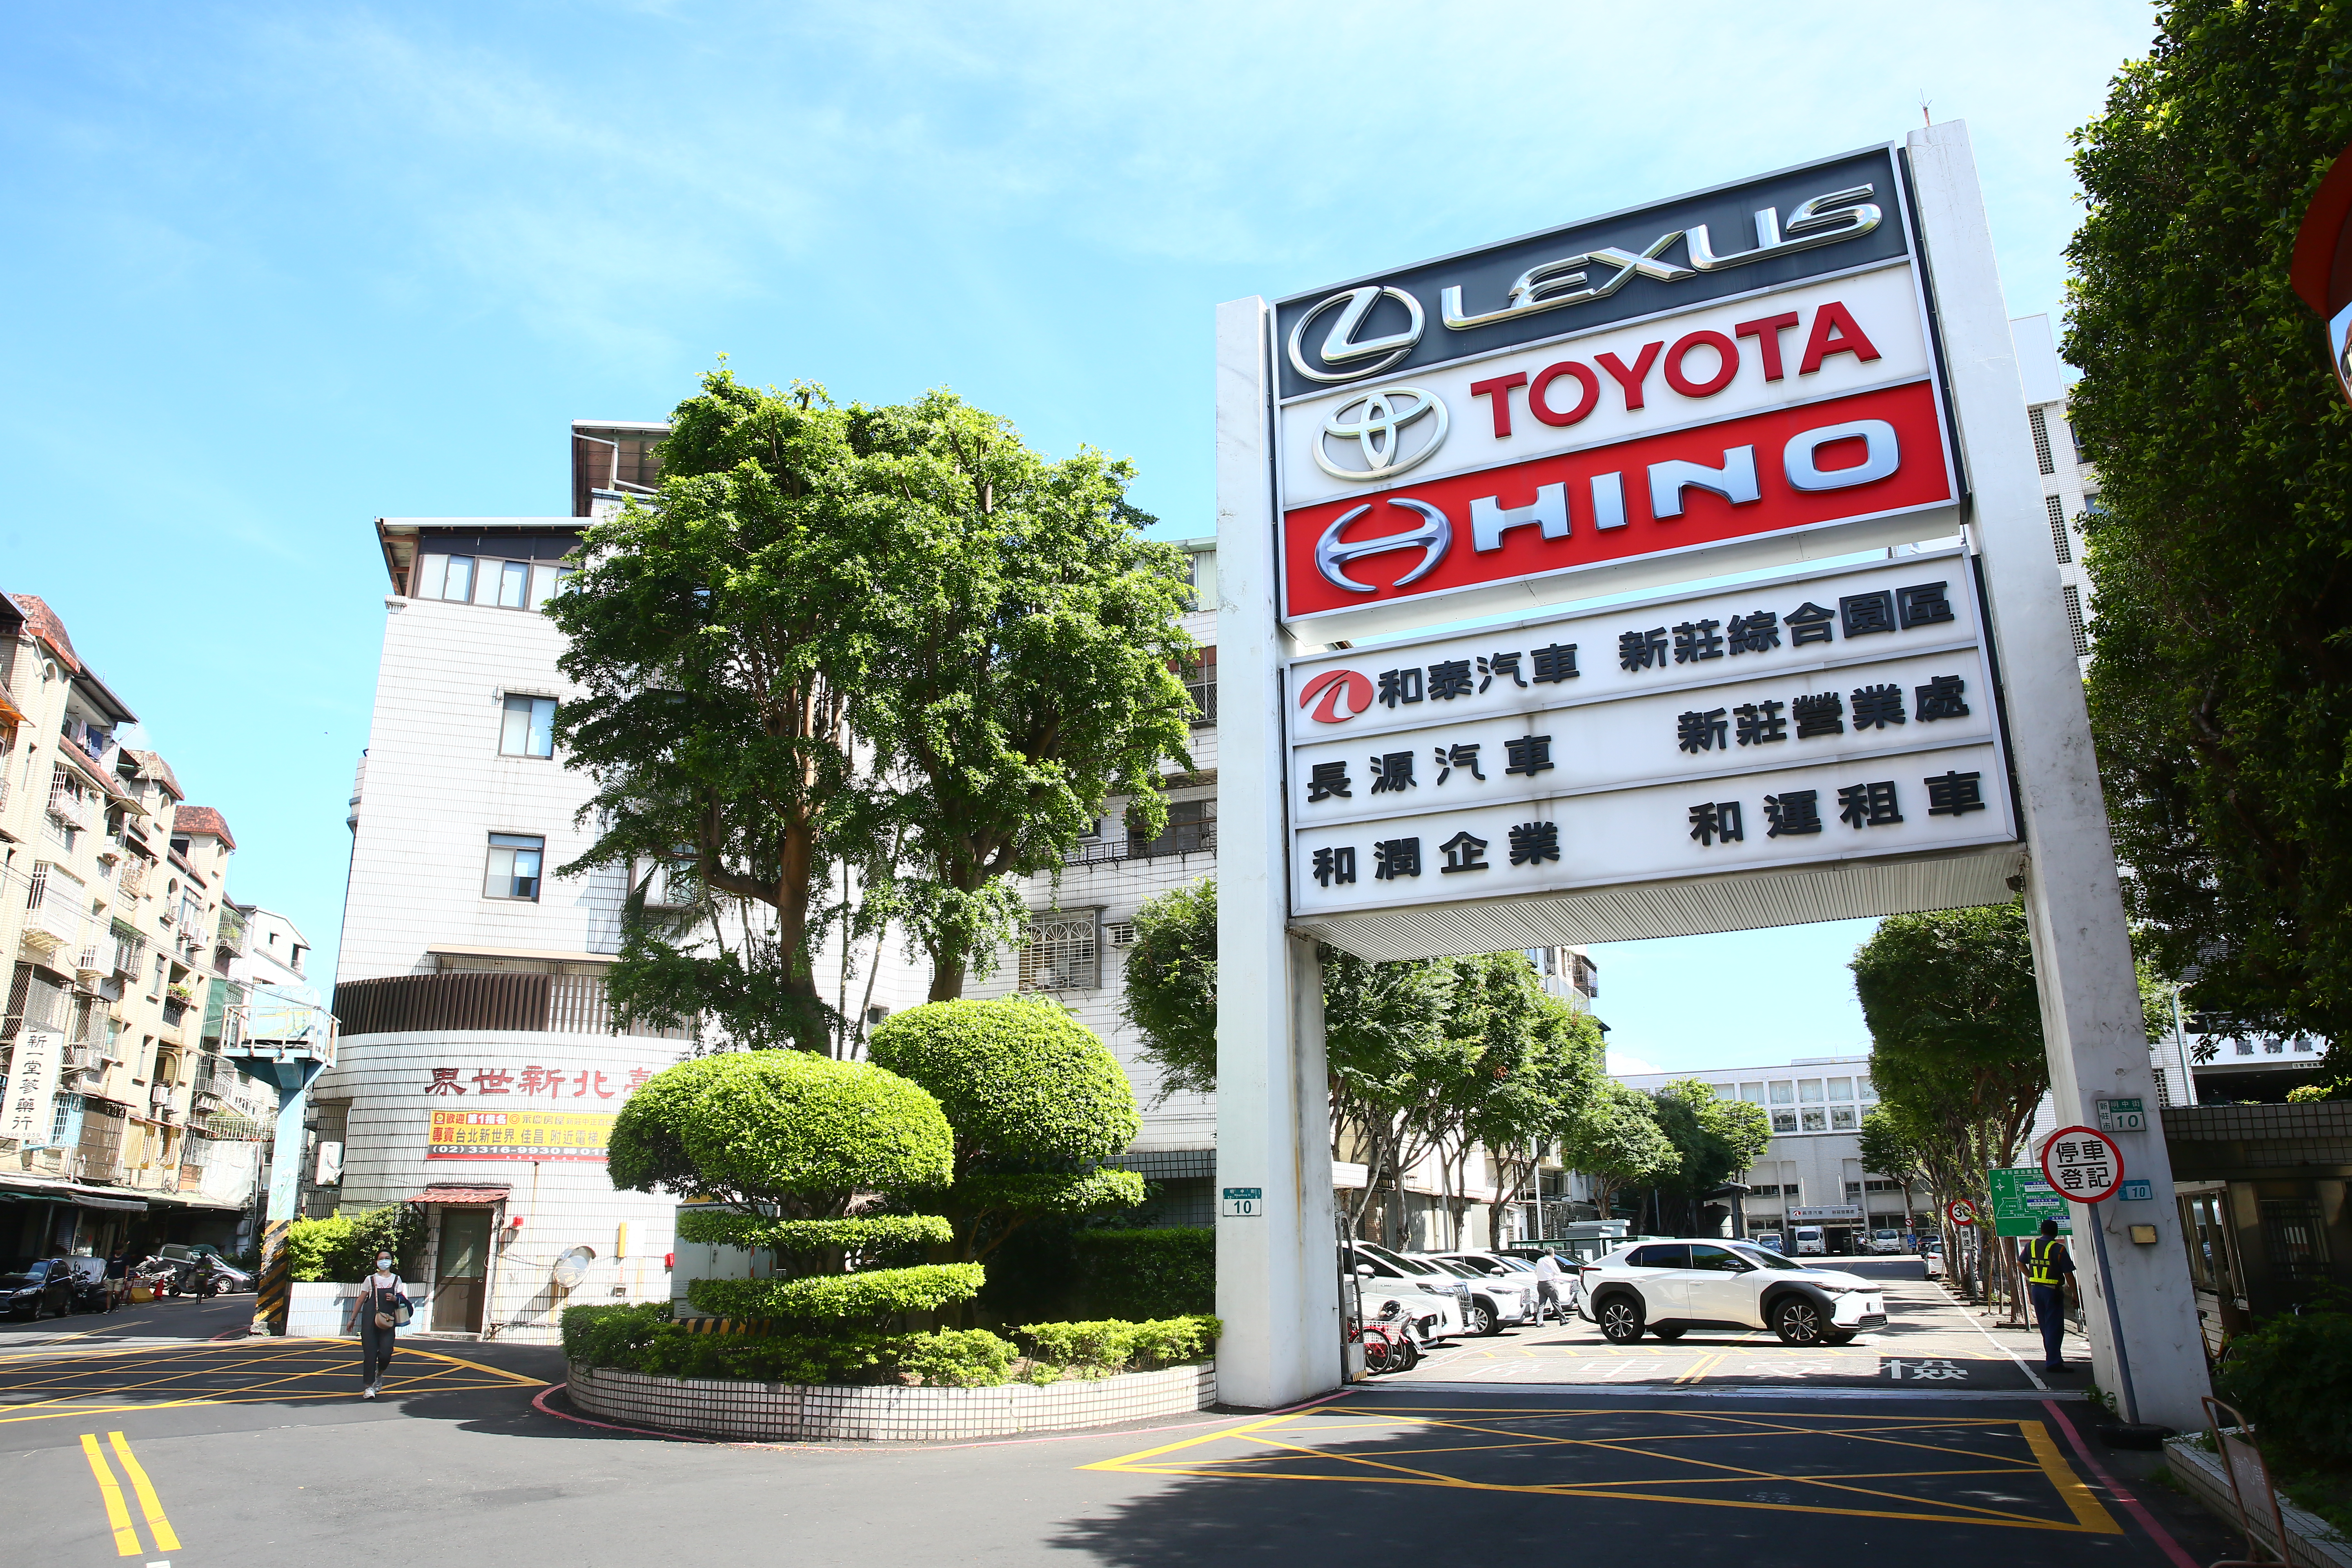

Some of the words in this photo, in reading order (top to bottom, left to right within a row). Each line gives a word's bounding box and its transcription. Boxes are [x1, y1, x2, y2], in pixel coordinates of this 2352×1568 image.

[1441, 183, 1882, 330] LEXUS
[1470, 301, 1882, 439] TOYOTA
[1470, 419, 1901, 553] HINO
[1378, 643, 1581, 708] 和泰汽車
[1619, 581, 1955, 672] 新莊綜合園區
[1307, 735, 1554, 802] 長源汽車
[1677, 675, 1969, 753] 新莊營業處
[1313, 821, 1560, 886] 和潤企業
[1689, 771, 1985, 846] 和運租車
[12, 1035, 48, 1130] 新一堂蔘藥行
[446, 1114, 465, 1124] 歡迎
[467, 1114, 507, 1124] 第1指名
[522, 1115, 564, 1125] 永慶房屋
[566, 1118, 615, 1126] 新莊中正直營
[2099, 1103, 2111, 1129] 新莊市
[2117, 1115, 2138, 1127] 10
[432, 1127, 454, 1142] 專賣
[468, 1146, 561, 1154] 3316-9930
[2056, 1140, 2105, 1163] 停車
[2061, 1167, 2111, 1189] 登記
[2132, 1187, 2145, 1198] 10
[1234, 1200, 1252, 1214] 10
[1962, 1231, 1971, 1246] 限速
